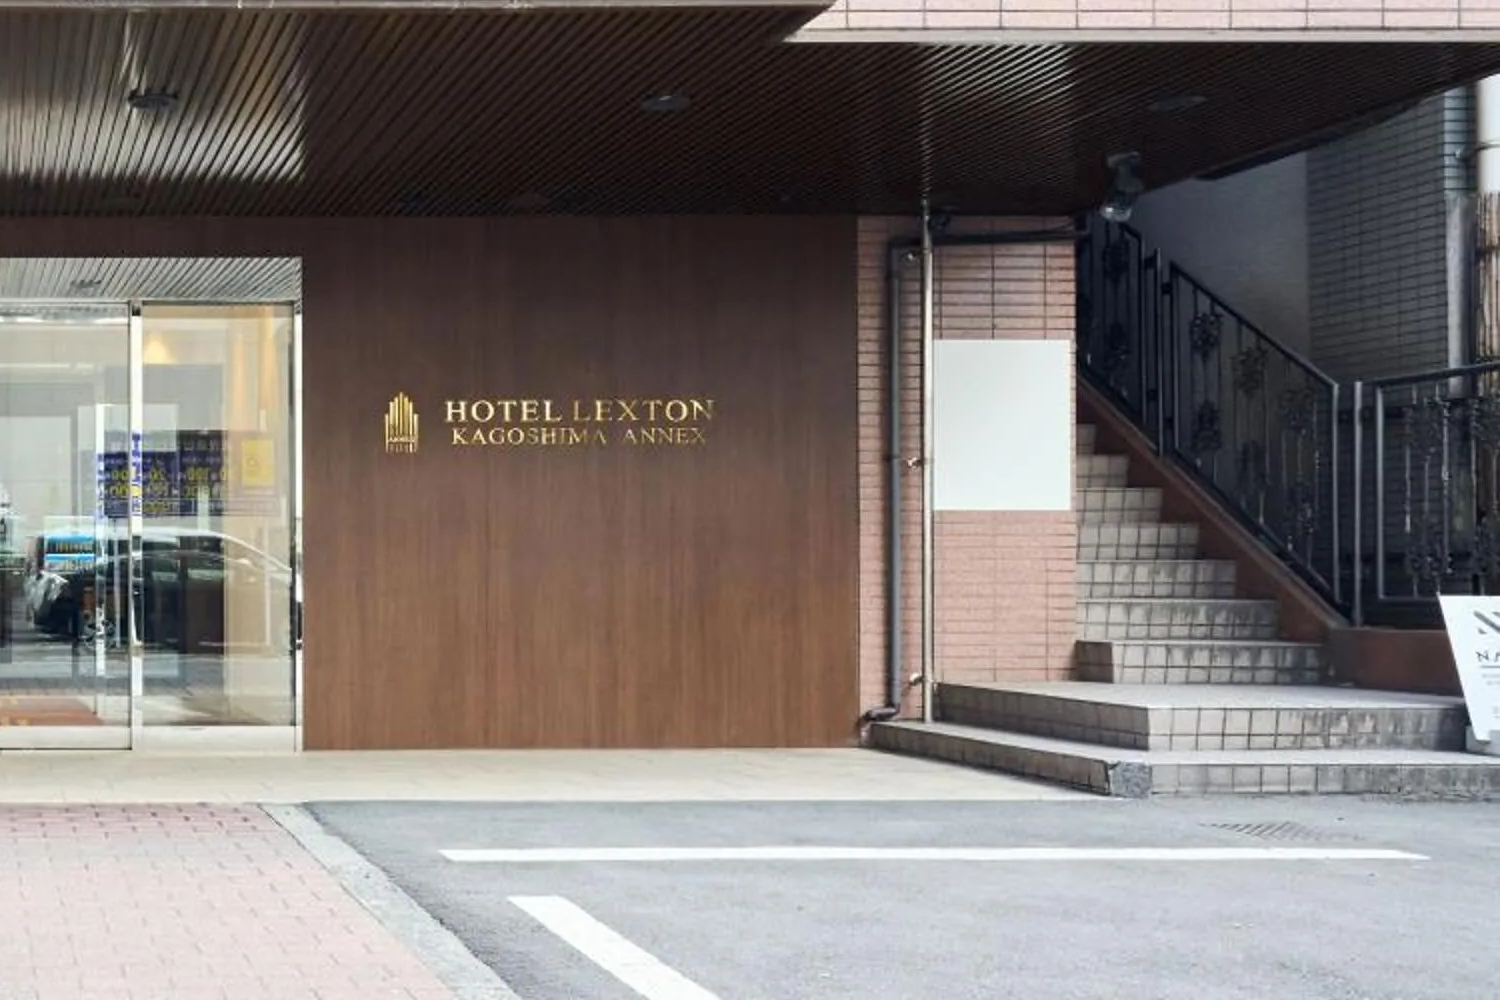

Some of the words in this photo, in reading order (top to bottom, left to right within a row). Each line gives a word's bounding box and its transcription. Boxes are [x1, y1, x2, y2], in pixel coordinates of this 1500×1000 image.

[444, 399, 563, 422] HOTEL
[573, 399, 714, 422] LEXTON
[451, 427, 607, 445] KAGOSHIMA
[624, 427, 707, 445] ANNEX
